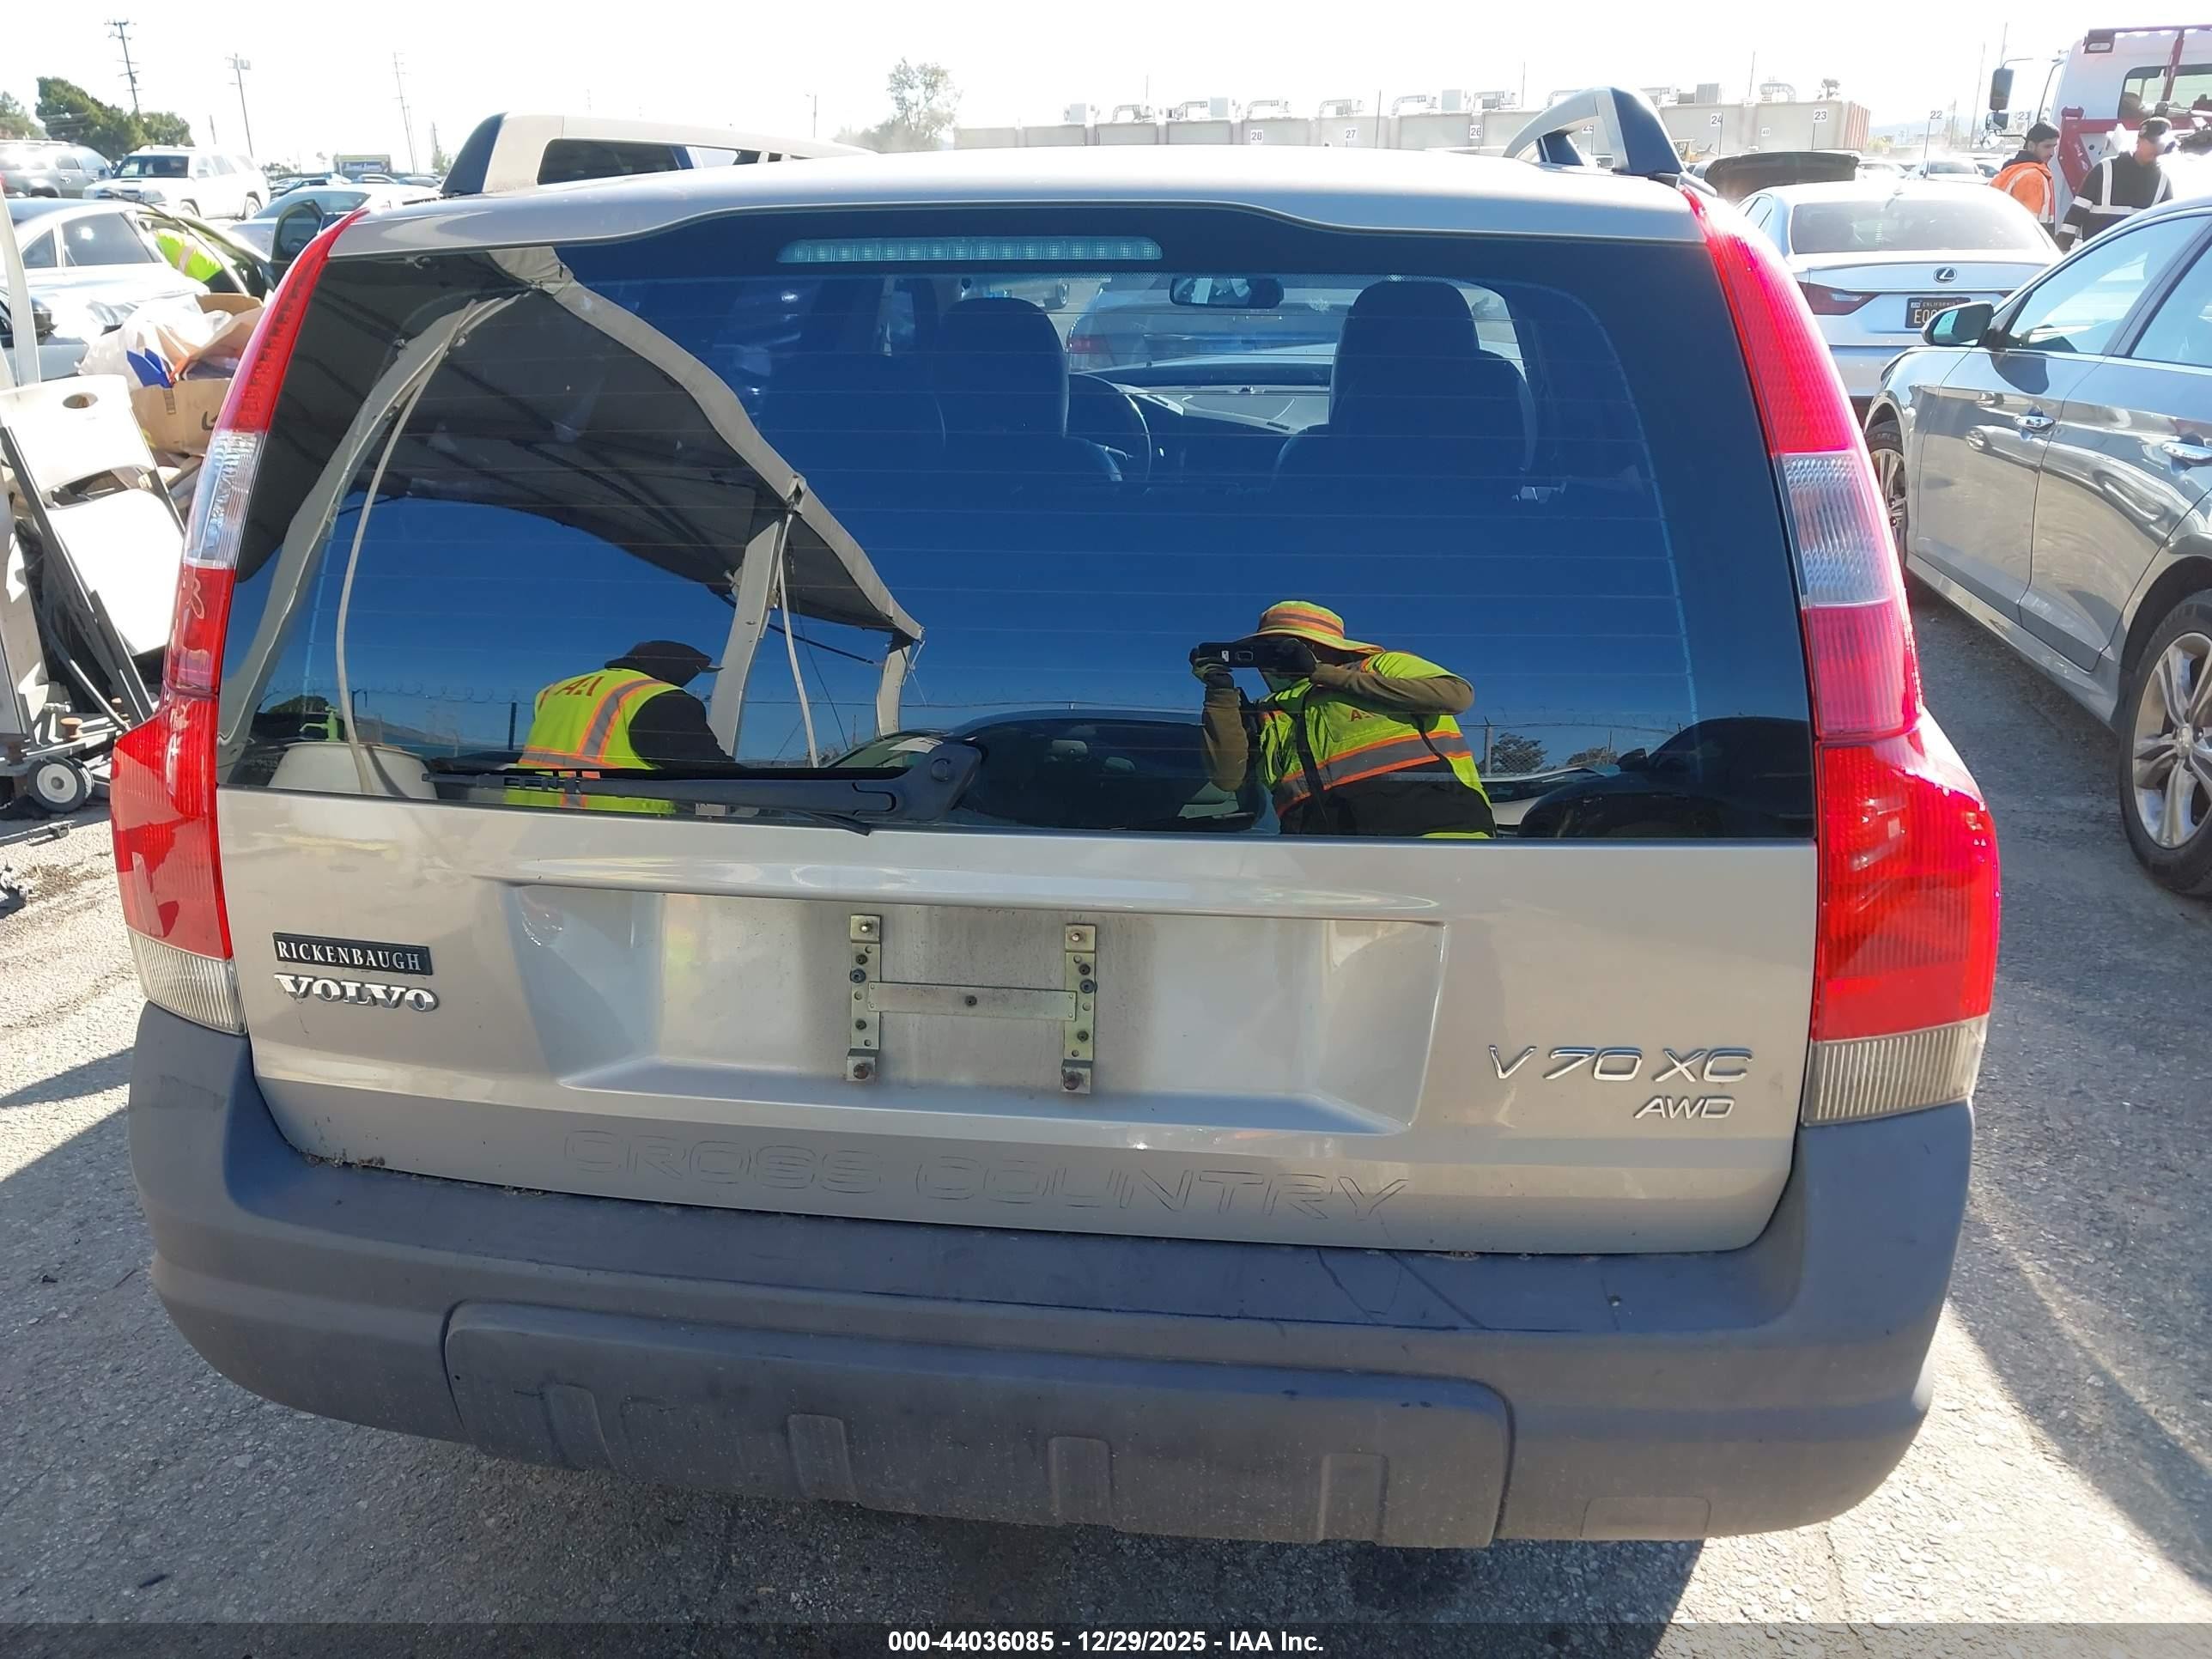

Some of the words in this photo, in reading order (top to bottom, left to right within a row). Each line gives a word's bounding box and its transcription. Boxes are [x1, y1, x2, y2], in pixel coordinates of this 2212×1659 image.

[1711, 115, 1723, 125] 24
[1814, 111, 1827, 121] 23
[1929, 110, 1943, 119] 22
[1346, 129, 1357, 139] 27
[1470, 127, 1481, 137] 26
[276, 940, 422, 971] RICKENBAUGH
[273, 972, 441, 1012] VOLVO
[1652, 1047, 1753, 1083] XC
[1633, 1095, 1735, 1120] AWD
[563, 1128, 883, 1195] CROSS
[915, 1155, 1410, 1221] COUNTRY
